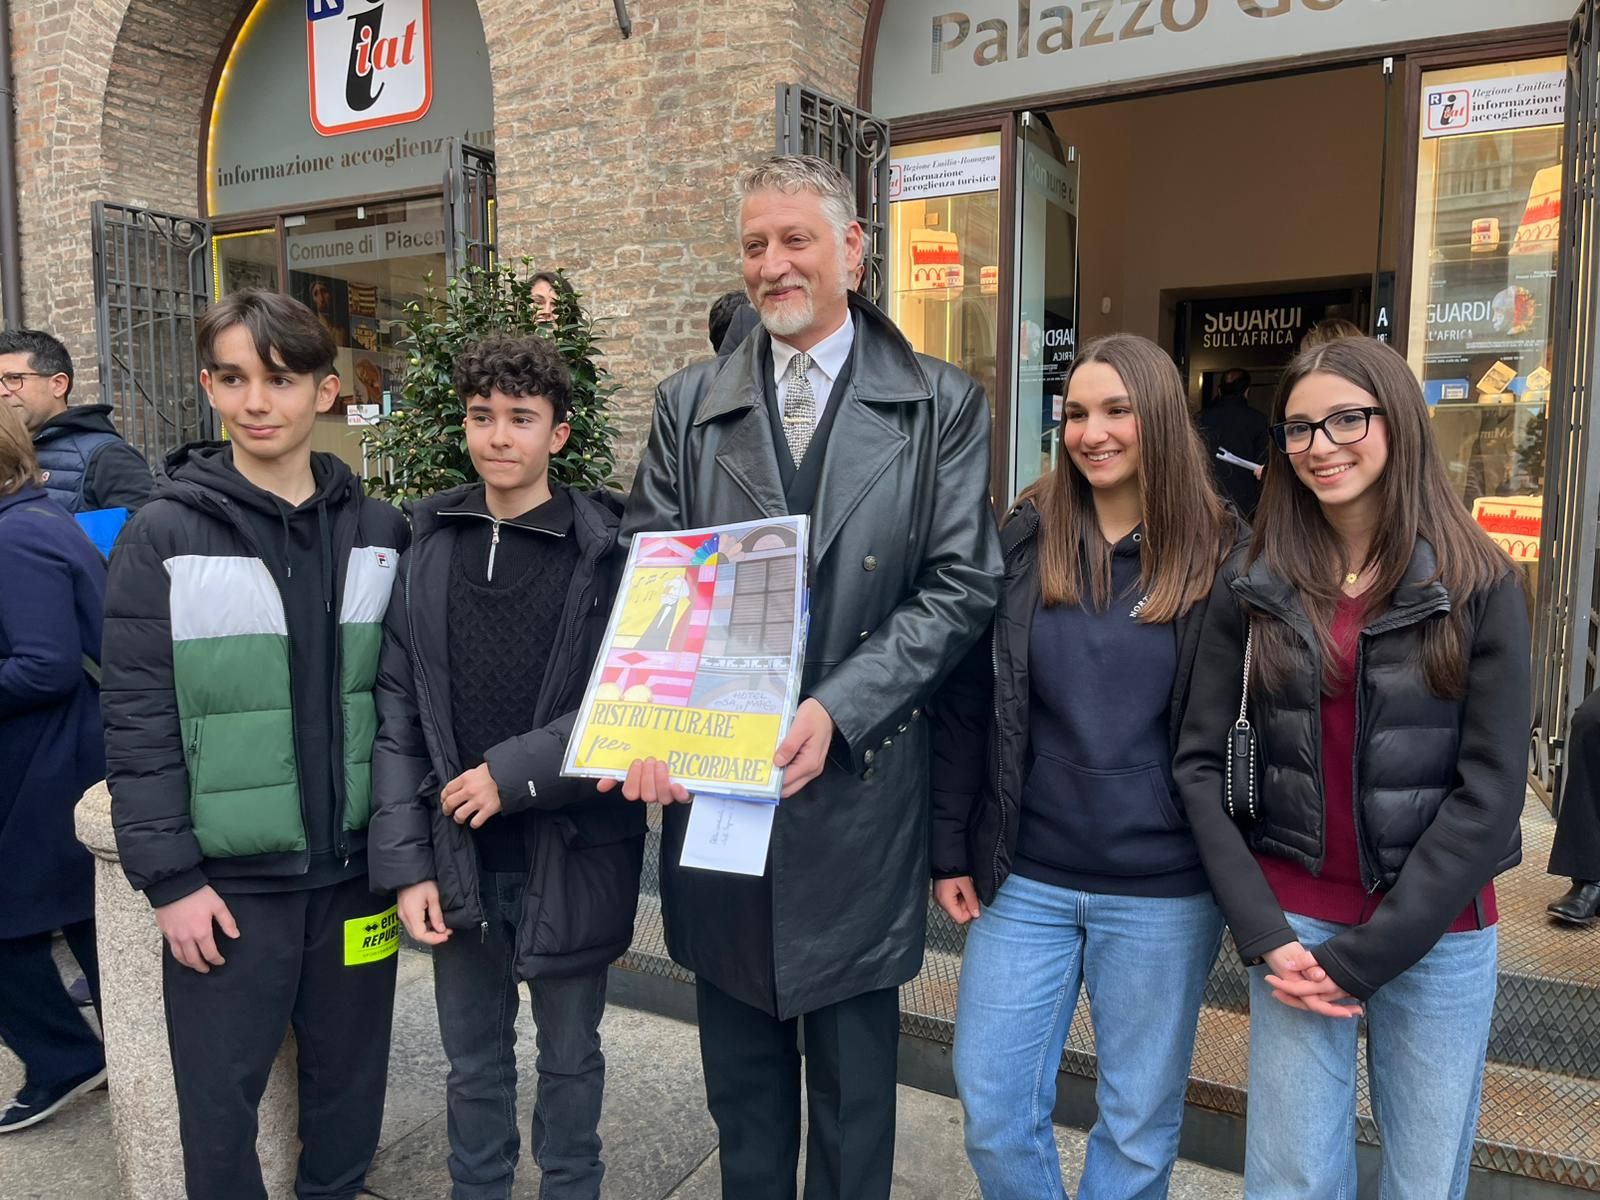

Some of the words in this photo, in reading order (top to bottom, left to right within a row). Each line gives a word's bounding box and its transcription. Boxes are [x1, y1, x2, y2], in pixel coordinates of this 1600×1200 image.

[355, 19, 417, 76] iat
[930, 0, 1208, 75] Palazzo
[1430, 94, 1441, 105] R
[1472, 86, 1513, 99] Regione
[1472, 94, 1561, 111] informazione
[1471, 107, 1548, 123] accoglienza
[218, 154, 334, 187] informazione
[903, 169, 964, 183] informazione
[903, 180, 955, 193] accoglienza
[957, 174, 997, 186] turistica
[289, 239, 354, 262] Comune
[358, 234, 373, 253] di
[385, 229, 445, 251] Piacen
[1204, 307, 1302, 333] SGUARDI
[1203, 330, 1293, 348] SULL'AFRICA
[590, 703, 740, 739] RISTRUTTURARE
[584, 734, 631, 763] per
[668, 750, 767, 782] RICORDARE
